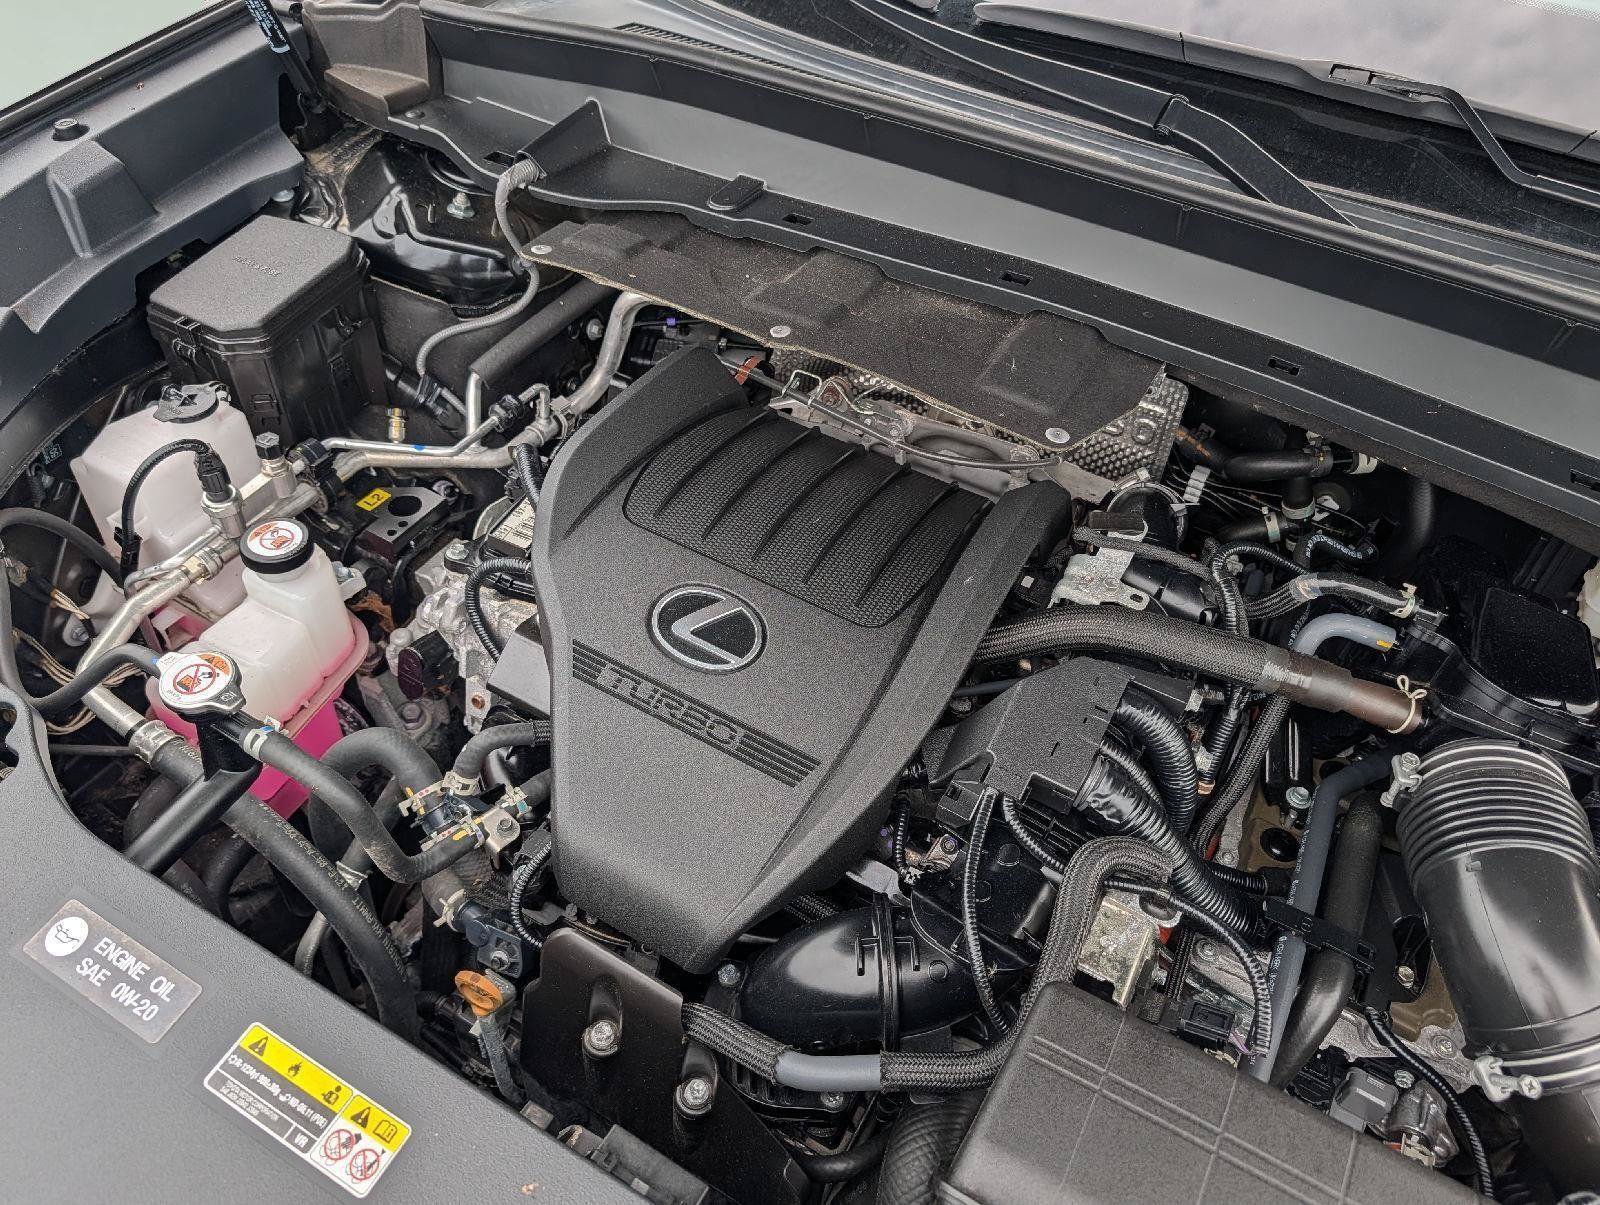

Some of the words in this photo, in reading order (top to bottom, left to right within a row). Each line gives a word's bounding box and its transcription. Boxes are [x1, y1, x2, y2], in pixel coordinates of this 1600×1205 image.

[604, 664, 741, 747] TURBO
[75, 957, 112, 988] SAE
[110, 982, 159, 1021] 0W-20
[93, 936, 151, 982] ENGINE
[149, 975, 176, 1002] OIL
[294, 1132, 309, 1148] VR
